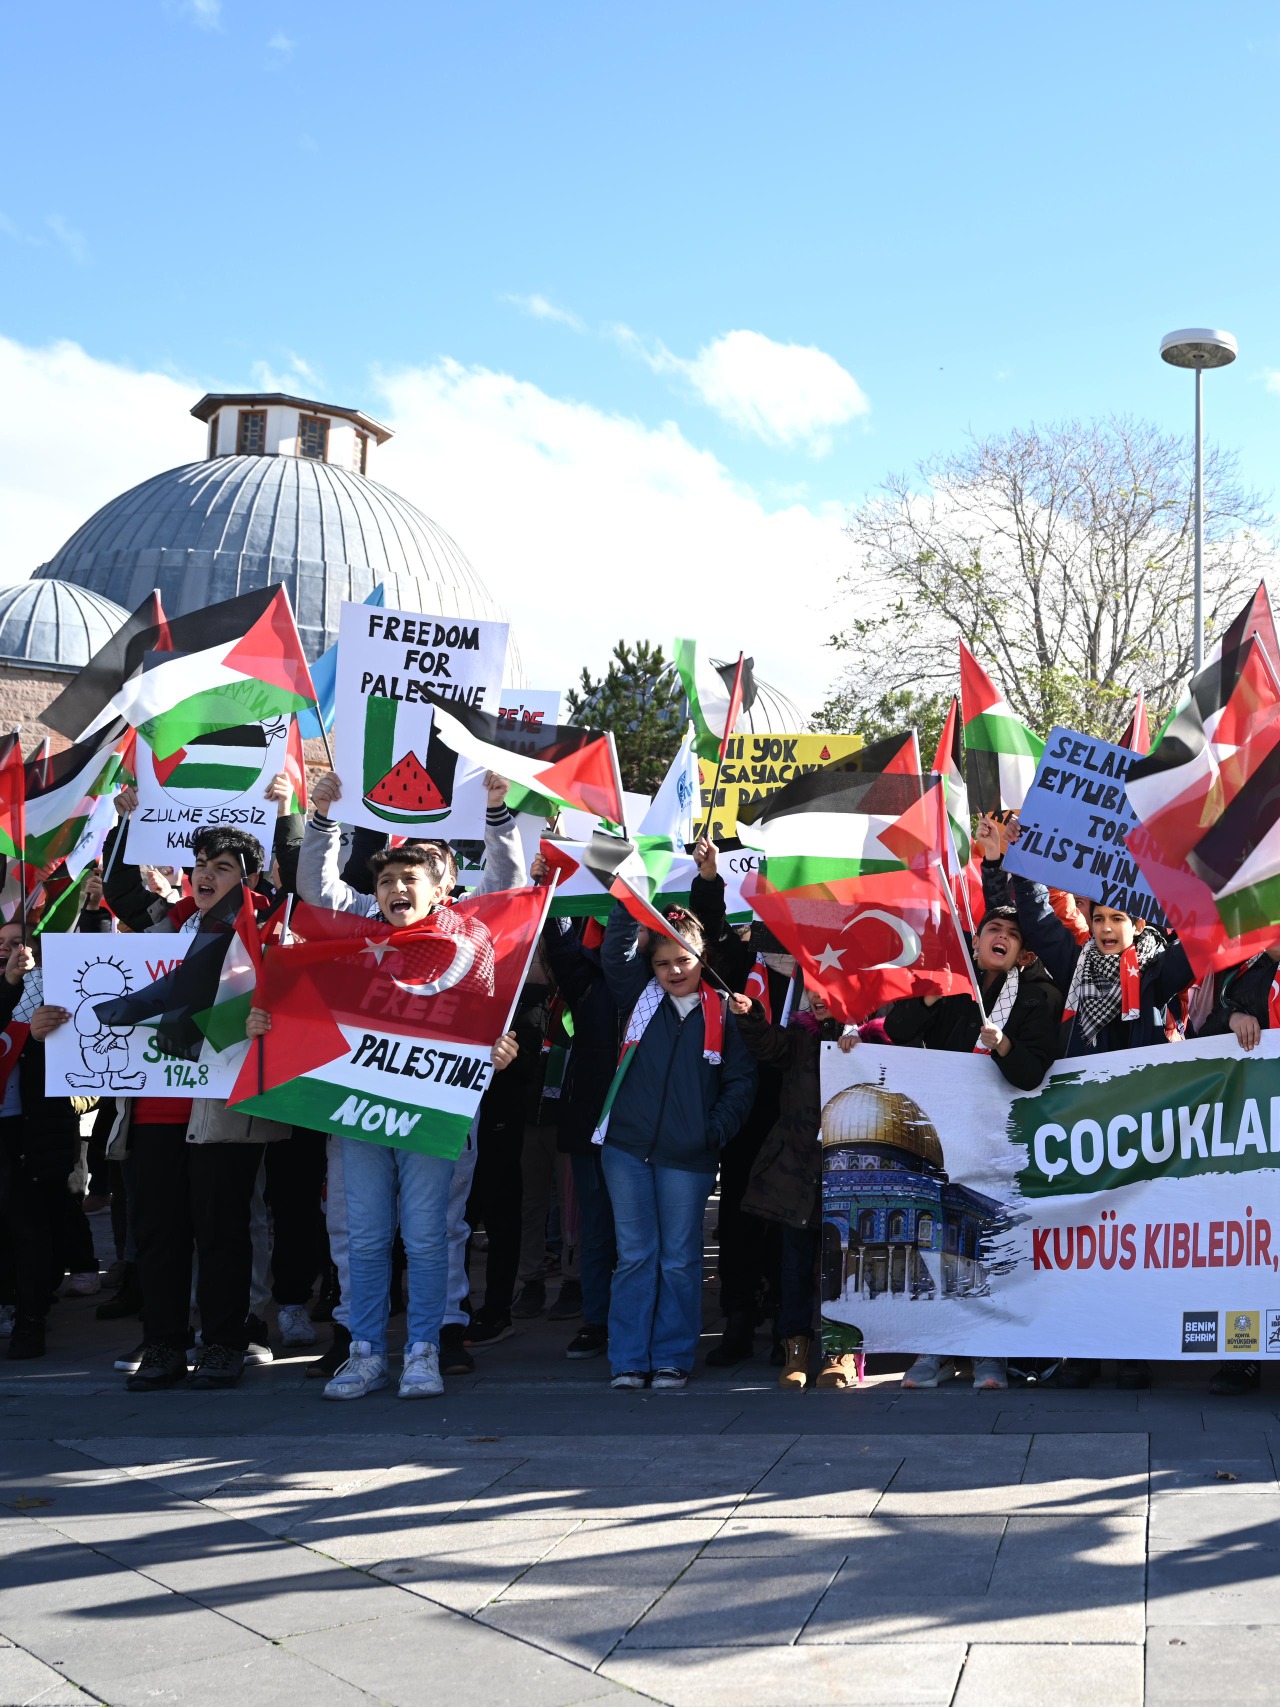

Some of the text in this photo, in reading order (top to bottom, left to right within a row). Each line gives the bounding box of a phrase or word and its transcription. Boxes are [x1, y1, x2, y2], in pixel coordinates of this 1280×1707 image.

[368, 614, 480, 651] FREEDOM
[403, 650, 452, 678] FOR
[750, 738, 799, 763] YOK
[1049, 736, 1137, 780] SELAH
[140, 806, 267, 825] ZULME SESSİZ
[359, 976, 461, 1026] FREE
[163, 1064, 210, 1089] 1948
[349, 1033, 493, 1093] PALESTINE
[329, 1094, 422, 1138] NOW
[1032, 1209, 1137, 1271] KUDÜS
[1143, 1205, 1280, 1273] KIBLEDİR,
